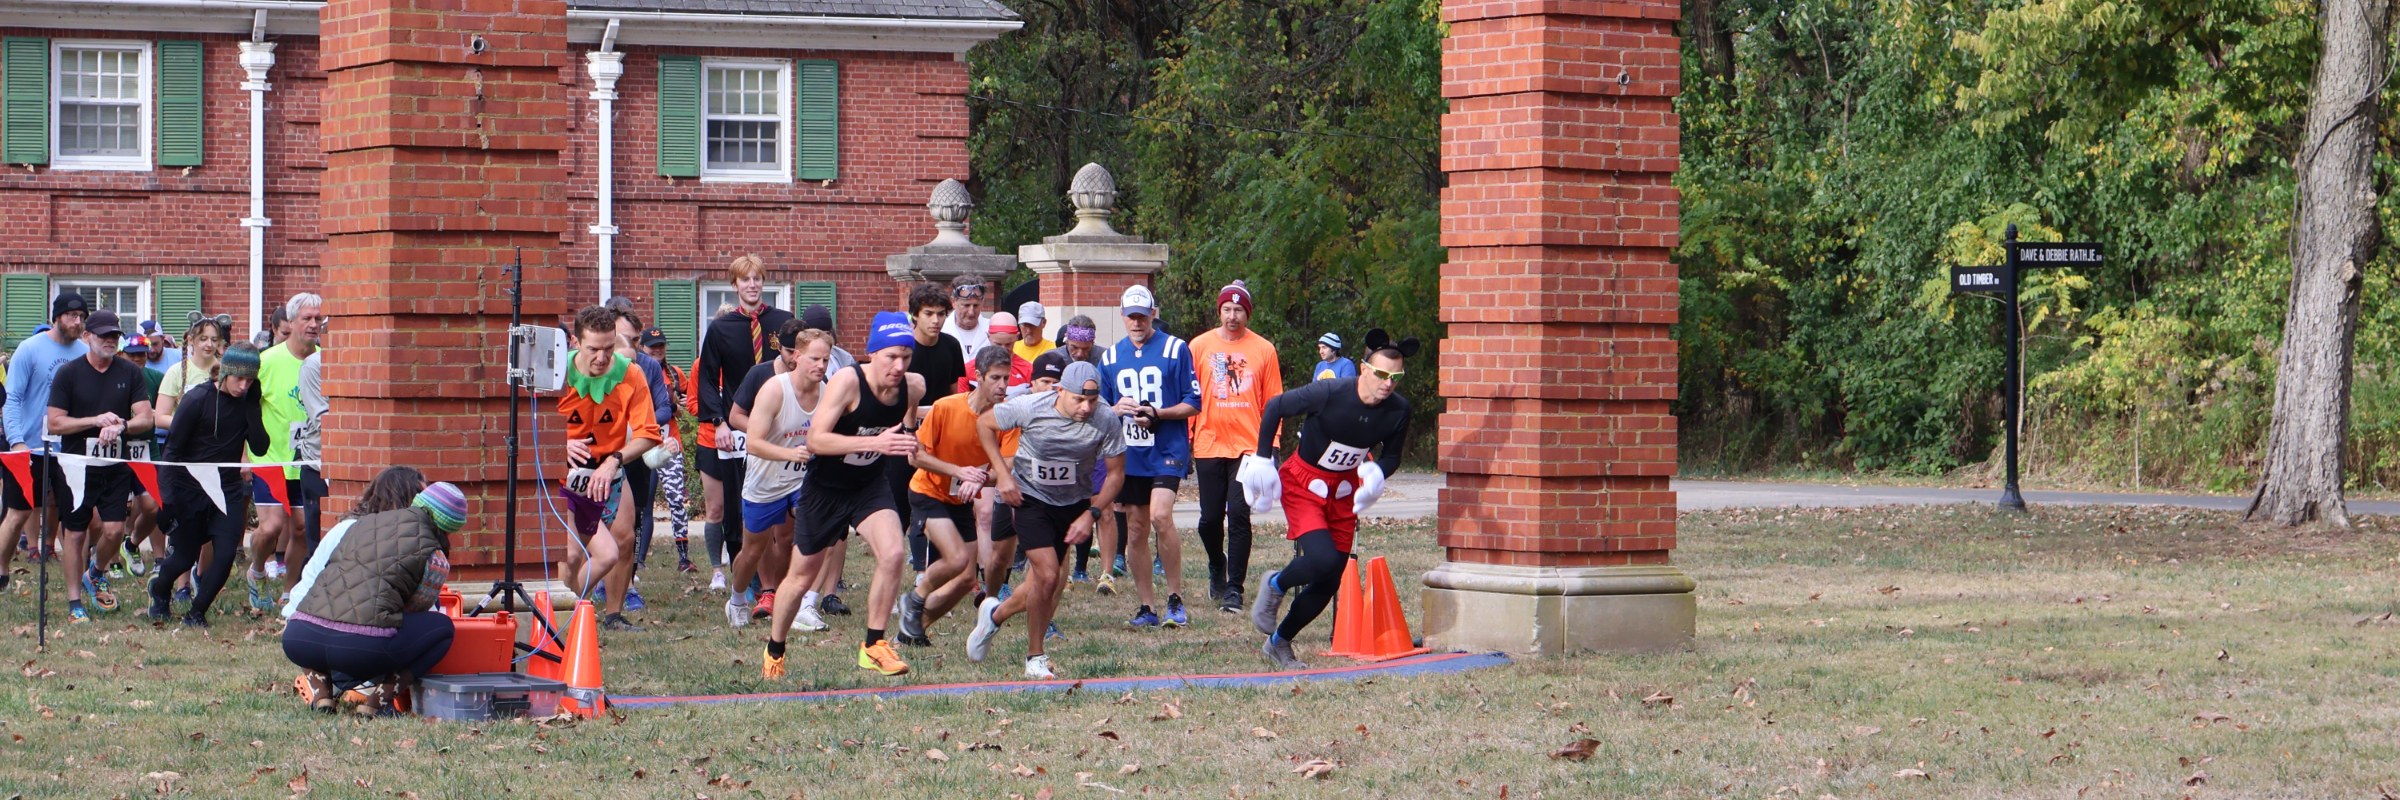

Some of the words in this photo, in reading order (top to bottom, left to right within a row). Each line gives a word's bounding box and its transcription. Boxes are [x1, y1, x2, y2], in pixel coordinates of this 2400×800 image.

[2020, 248, 2038, 262] DAVE
[2039, 248, 2045, 262] &
[2046, 248, 2069, 262] DEBBIE
[2070, 248, 2096, 262] RATHJE
[1959, 273, 1972, 286] OLD
[1972, 272, 1994, 286] TIMBER
[1117, 366, 1163, 410] 98
[1126, 423, 1149, 440] 438
[92, 443, 118, 459] 416
[1328, 449, 1362, 467] 515
[1038, 465, 1070, 480] 512
